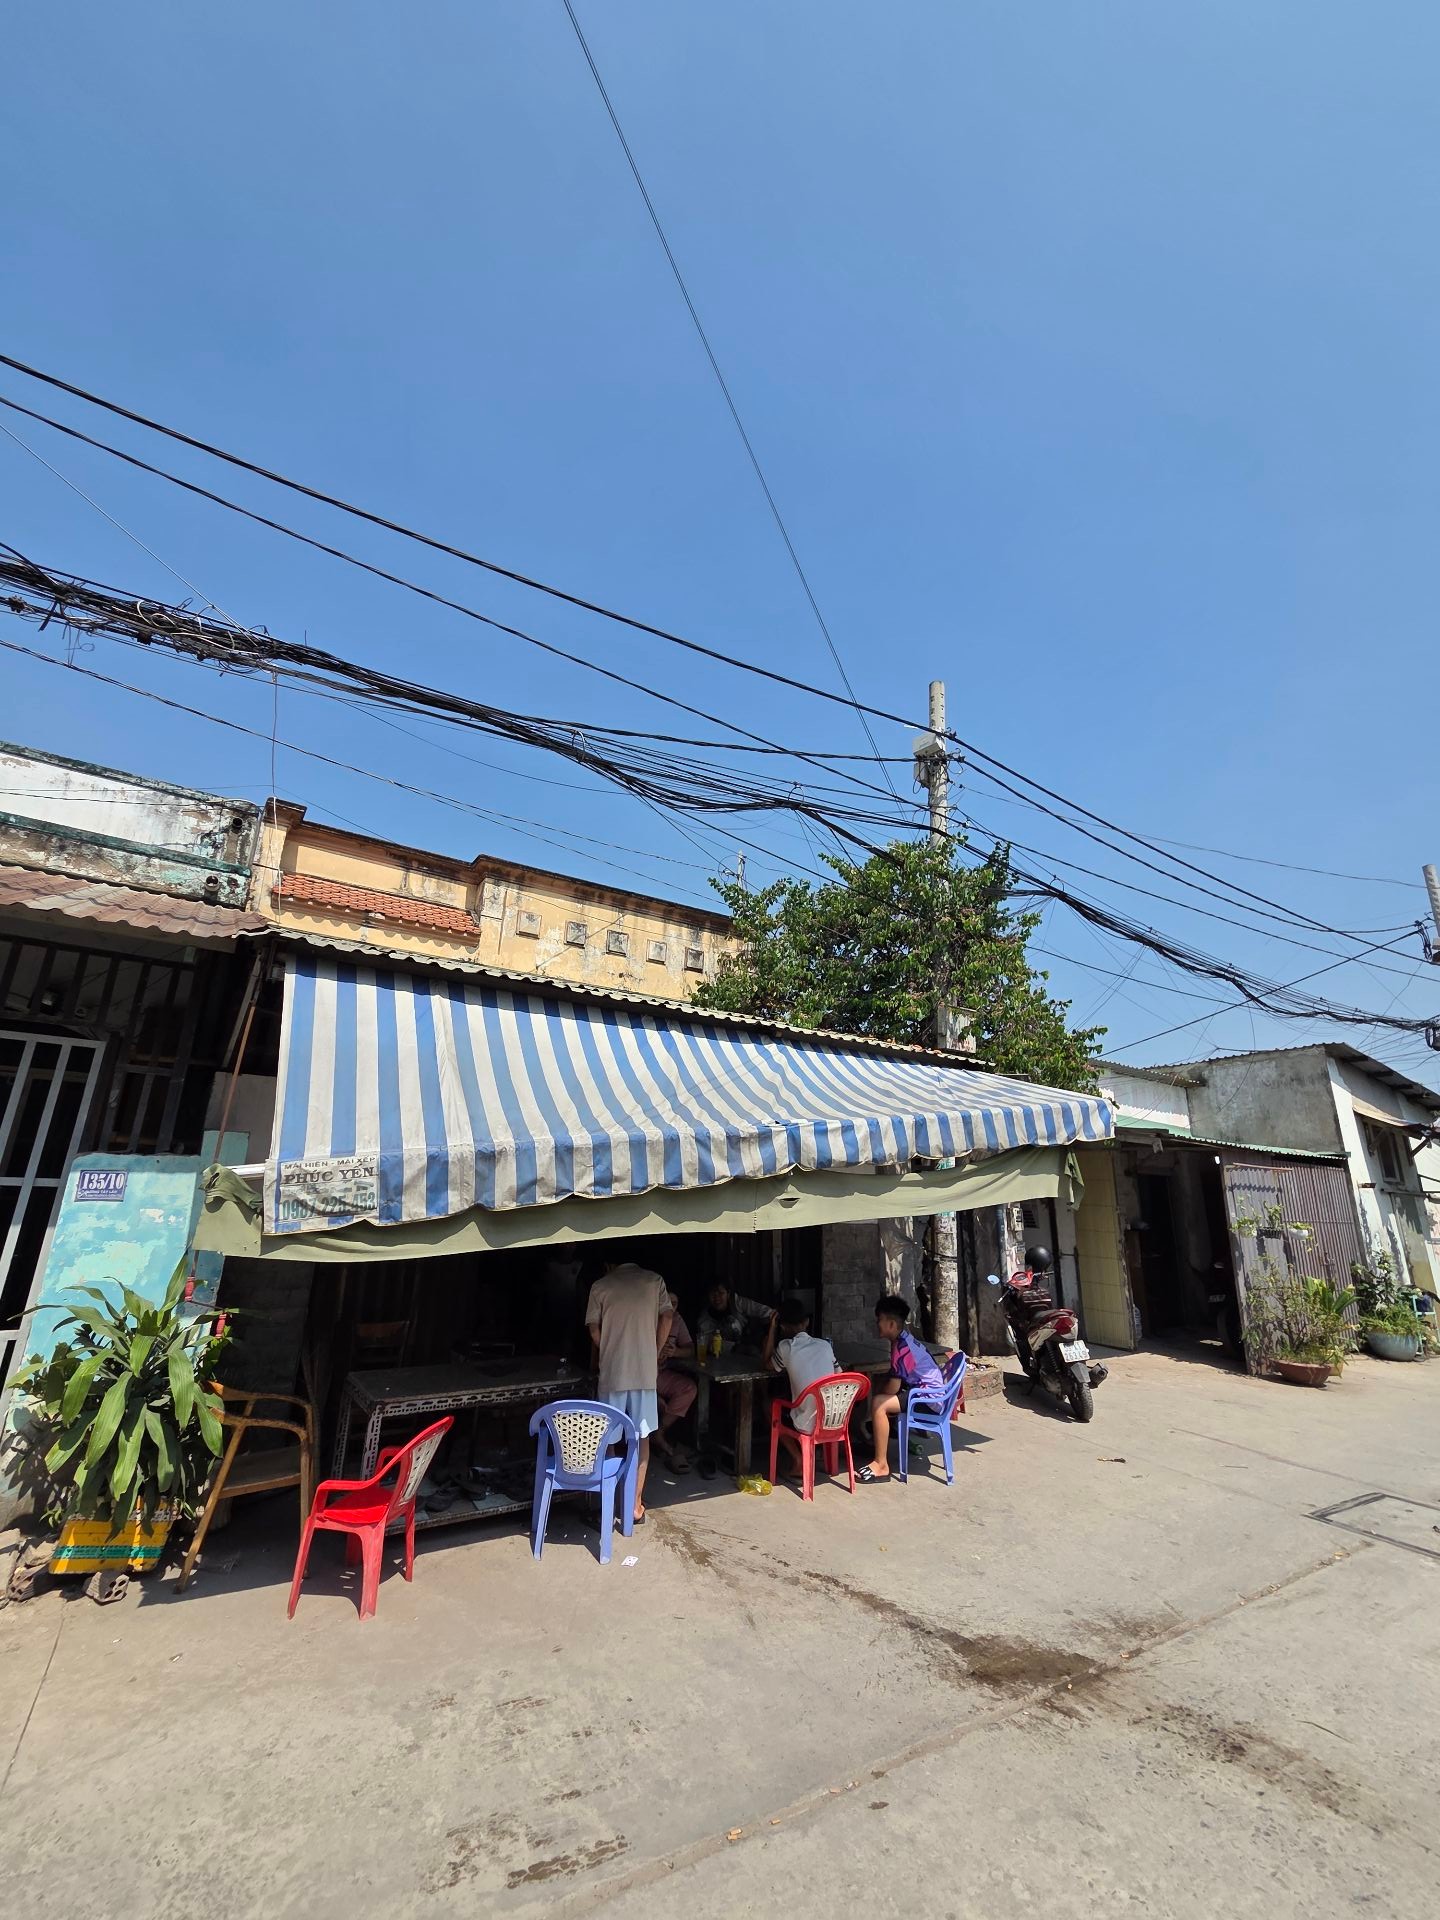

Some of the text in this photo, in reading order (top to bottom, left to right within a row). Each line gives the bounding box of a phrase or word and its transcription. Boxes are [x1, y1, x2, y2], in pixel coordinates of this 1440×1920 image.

[82, 1173, 125, 1190] 135/10
[283, 1163, 375, 1184] PHÚC YẾN
